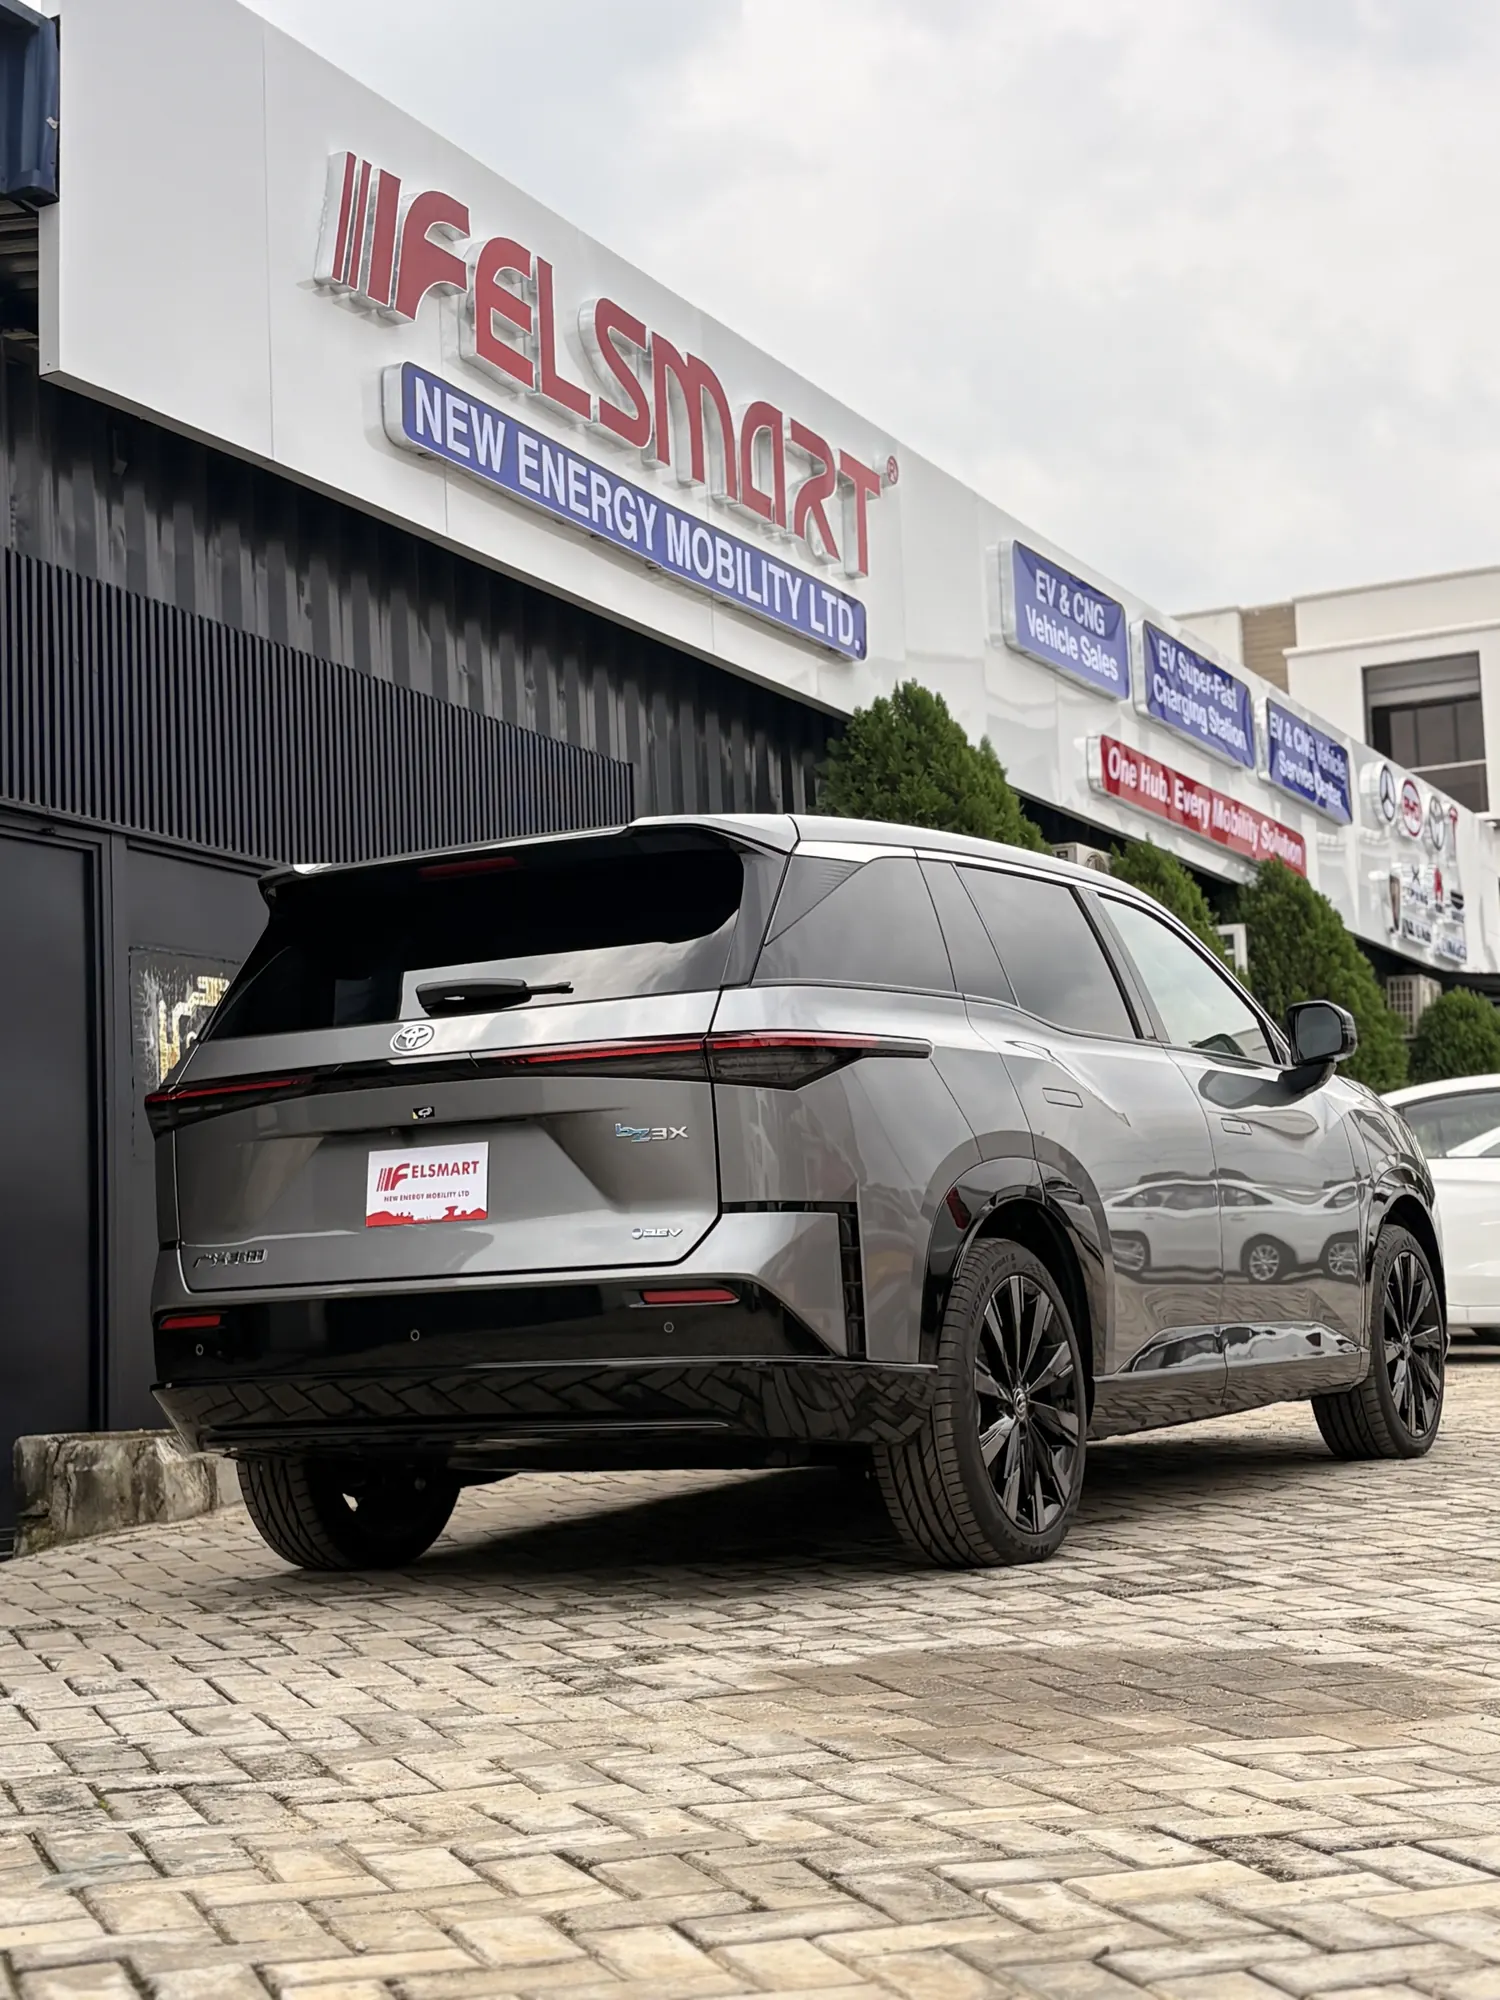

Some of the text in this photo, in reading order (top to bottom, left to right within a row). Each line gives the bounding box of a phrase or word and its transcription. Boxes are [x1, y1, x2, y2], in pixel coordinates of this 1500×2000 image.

[332, 151, 881, 577] FELSMART
[414, 376, 861, 651] NEW ENERGY MOBILITY LTD.
[1035, 568, 1105, 637] EV & CNG
[1025, 604, 1119, 681] Vehicle Sales
[1158, 639, 1238, 713] EV Super-Fast
[1153, 673, 1248, 751] Charging Station
[1269, 711, 1283, 741] EV
[1284, 721, 1294, 749] &
[1294, 726, 1315, 761] CNG
[1107, 746, 1137, 789] One
[1174, 778, 1211, 830] Every
[1212, 797, 1259, 851] Mobility
[376, 1160, 480, 1192] FELSMART
[400, 1194, 424, 1202] ENERGY
[426, 1191, 456, 1199] MOBILITY
[458, 1190, 470, 1198] LTD
